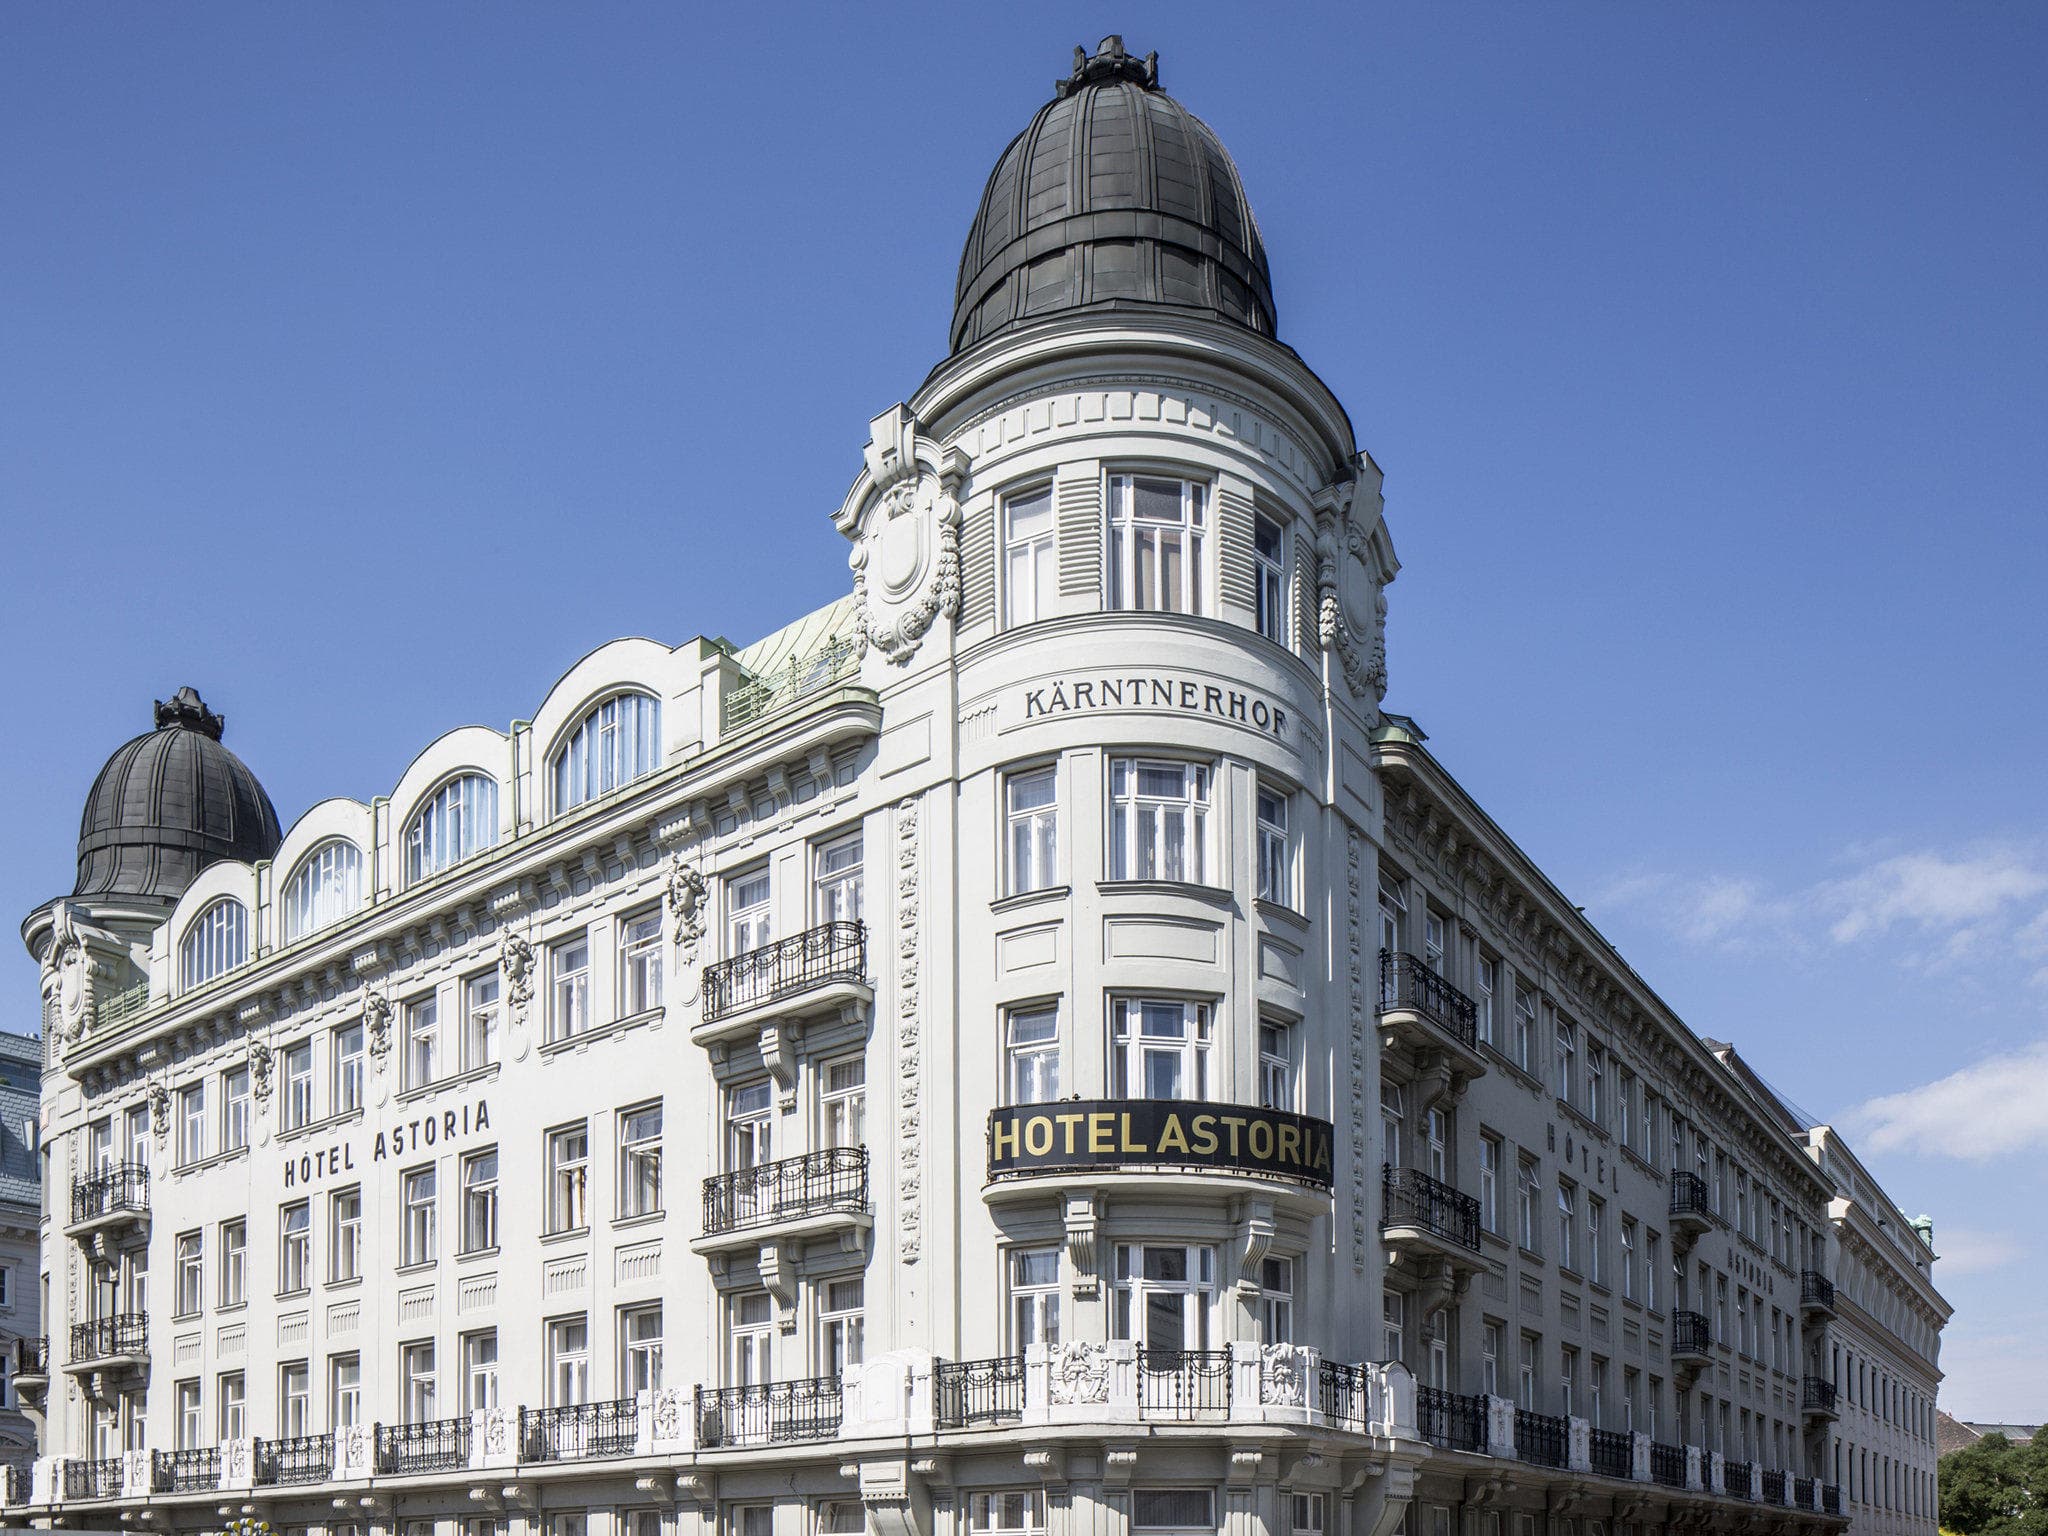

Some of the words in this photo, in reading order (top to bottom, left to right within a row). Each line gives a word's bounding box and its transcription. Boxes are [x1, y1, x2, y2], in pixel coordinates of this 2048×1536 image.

[1025, 679, 1288, 734] KÄRNTNERHOF
[374, 1099, 490, 1162] ASTORIA
[994, 1112, 1147, 1161] HOTEL
[1156, 1113, 1331, 1175] ASTORIA
[1727, 1246, 1774, 1296] ASTORIA
